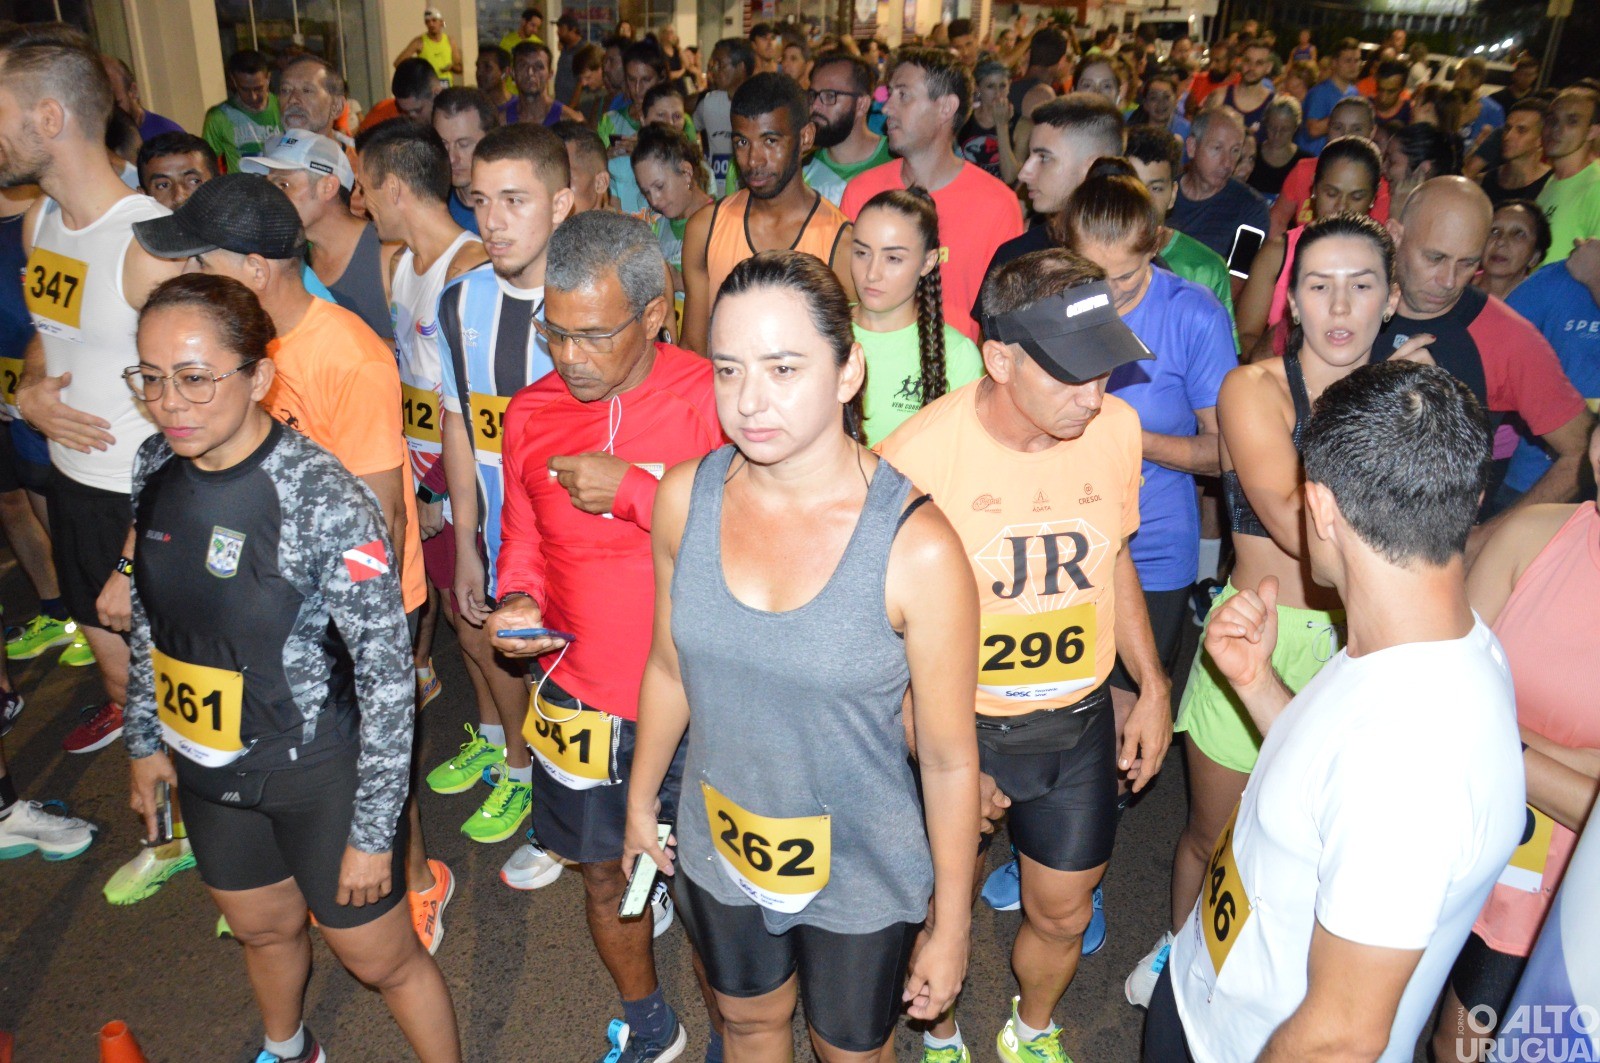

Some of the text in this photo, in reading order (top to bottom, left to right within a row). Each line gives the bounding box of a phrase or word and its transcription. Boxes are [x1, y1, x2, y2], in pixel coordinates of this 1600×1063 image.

[31, 265, 79, 308] 347
[1078, 494, 1102, 505] CRESOL
[992, 531, 1095, 599] JR
[981, 625, 1085, 671] 296
[160, 672, 222, 732] 261
[718, 809, 815, 877] 262
[425, 899, 437, 936] FILA
